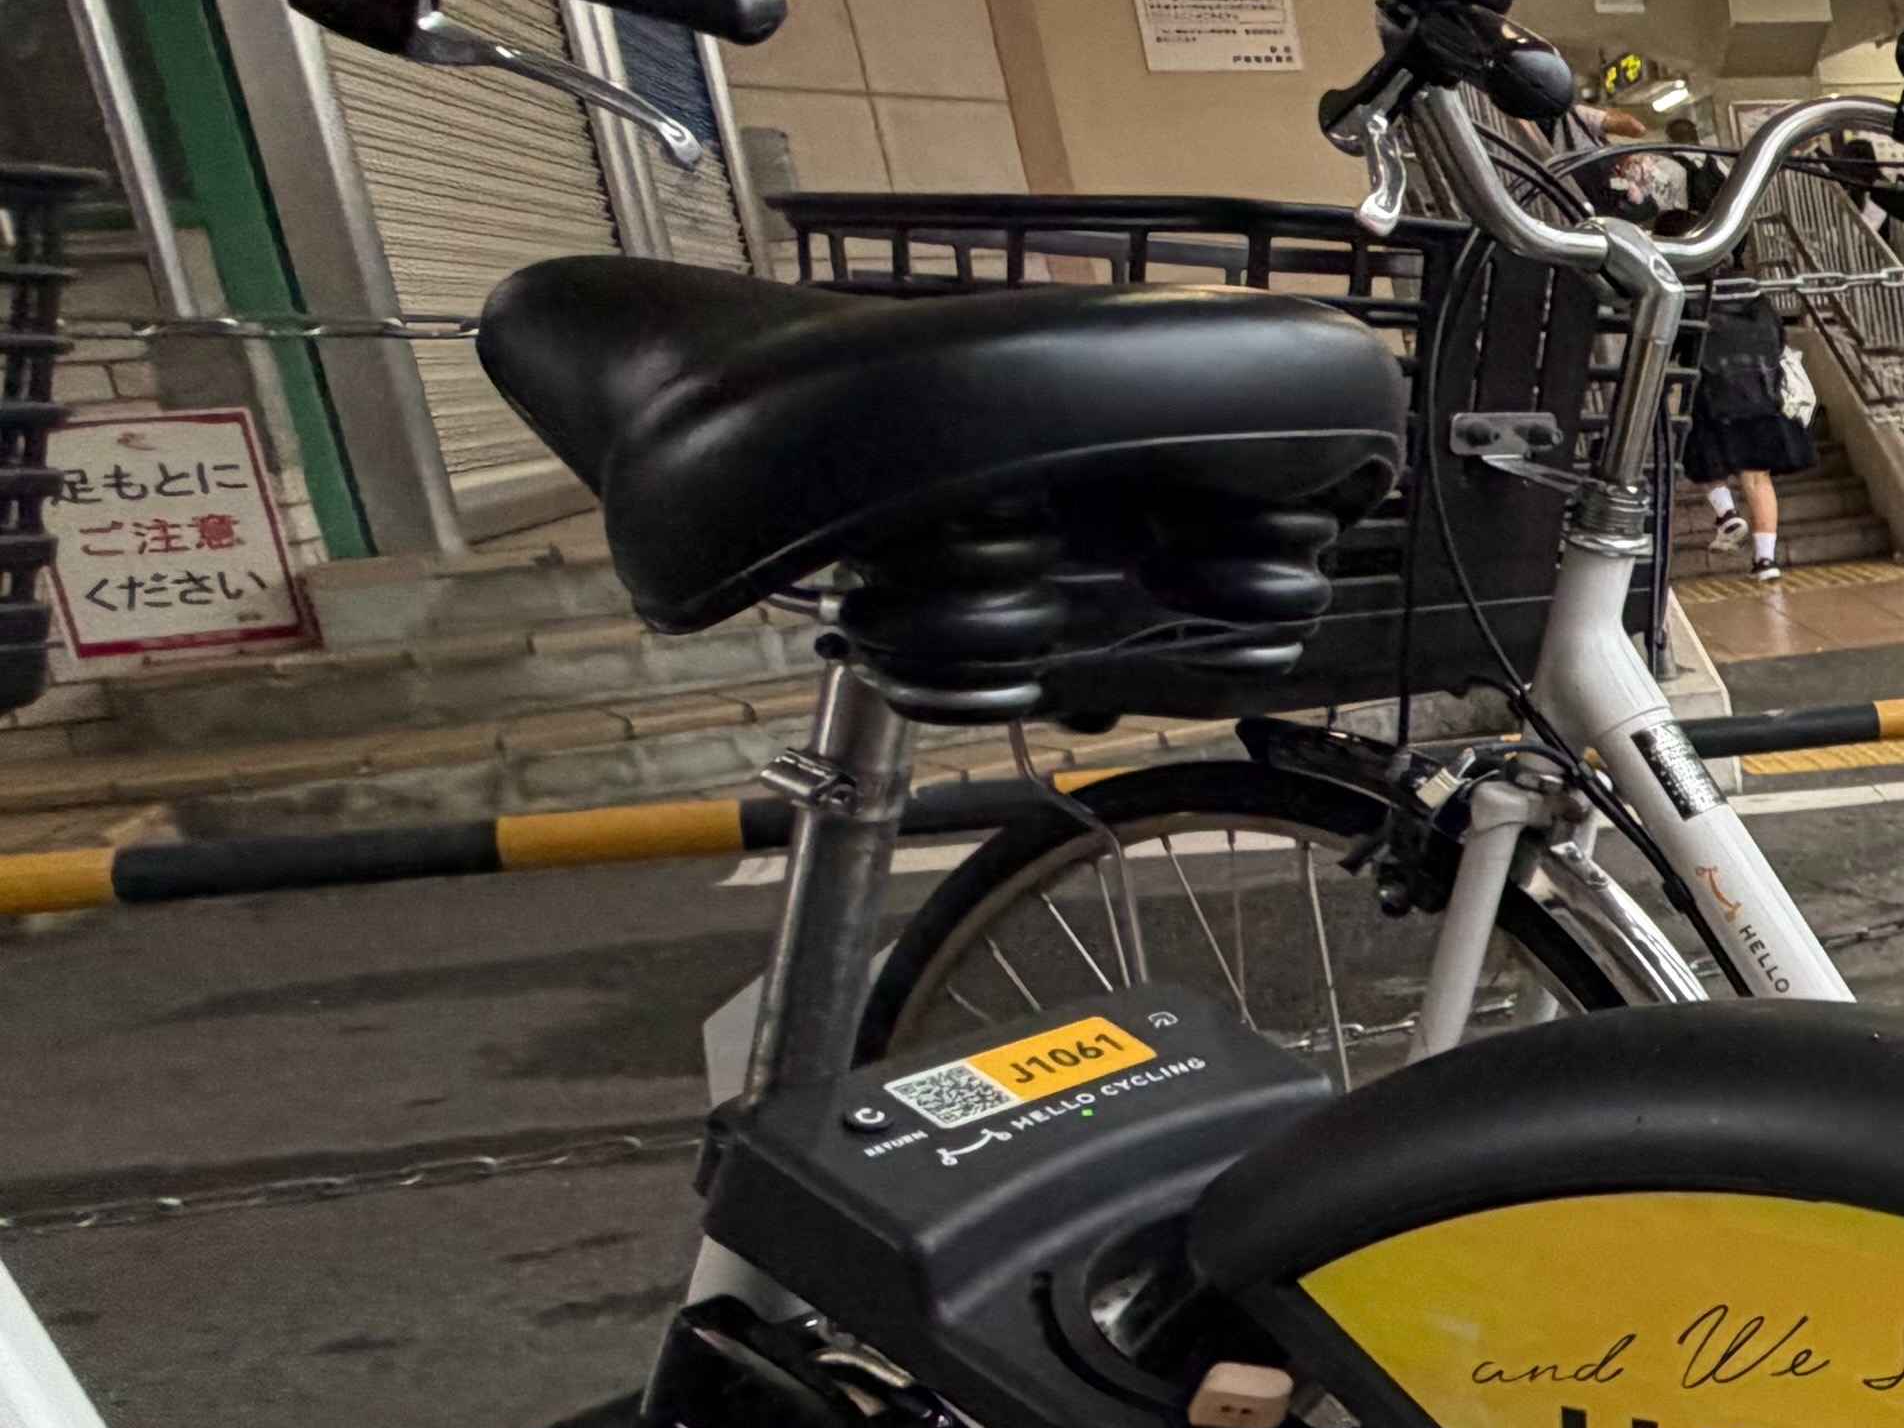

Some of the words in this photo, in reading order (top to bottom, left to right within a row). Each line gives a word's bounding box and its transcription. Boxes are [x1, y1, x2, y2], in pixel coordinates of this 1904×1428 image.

[52, 462, 249, 505] 足もとに
[78, 513, 245, 557] ご注意
[84, 570, 268, 611] ください
[1739, 924, 1791, 994] HELLO
[1011, 1032, 1126, 1085] J1061
[1010, 1091, 1097, 1132] HELLO
[1103, 1057, 1206, 1099] CYCLING
[863, 1129, 929, 1158] RETURN
[1472, 1332, 1639, 1387] and
[1677, 1303, 1830, 1392] We
